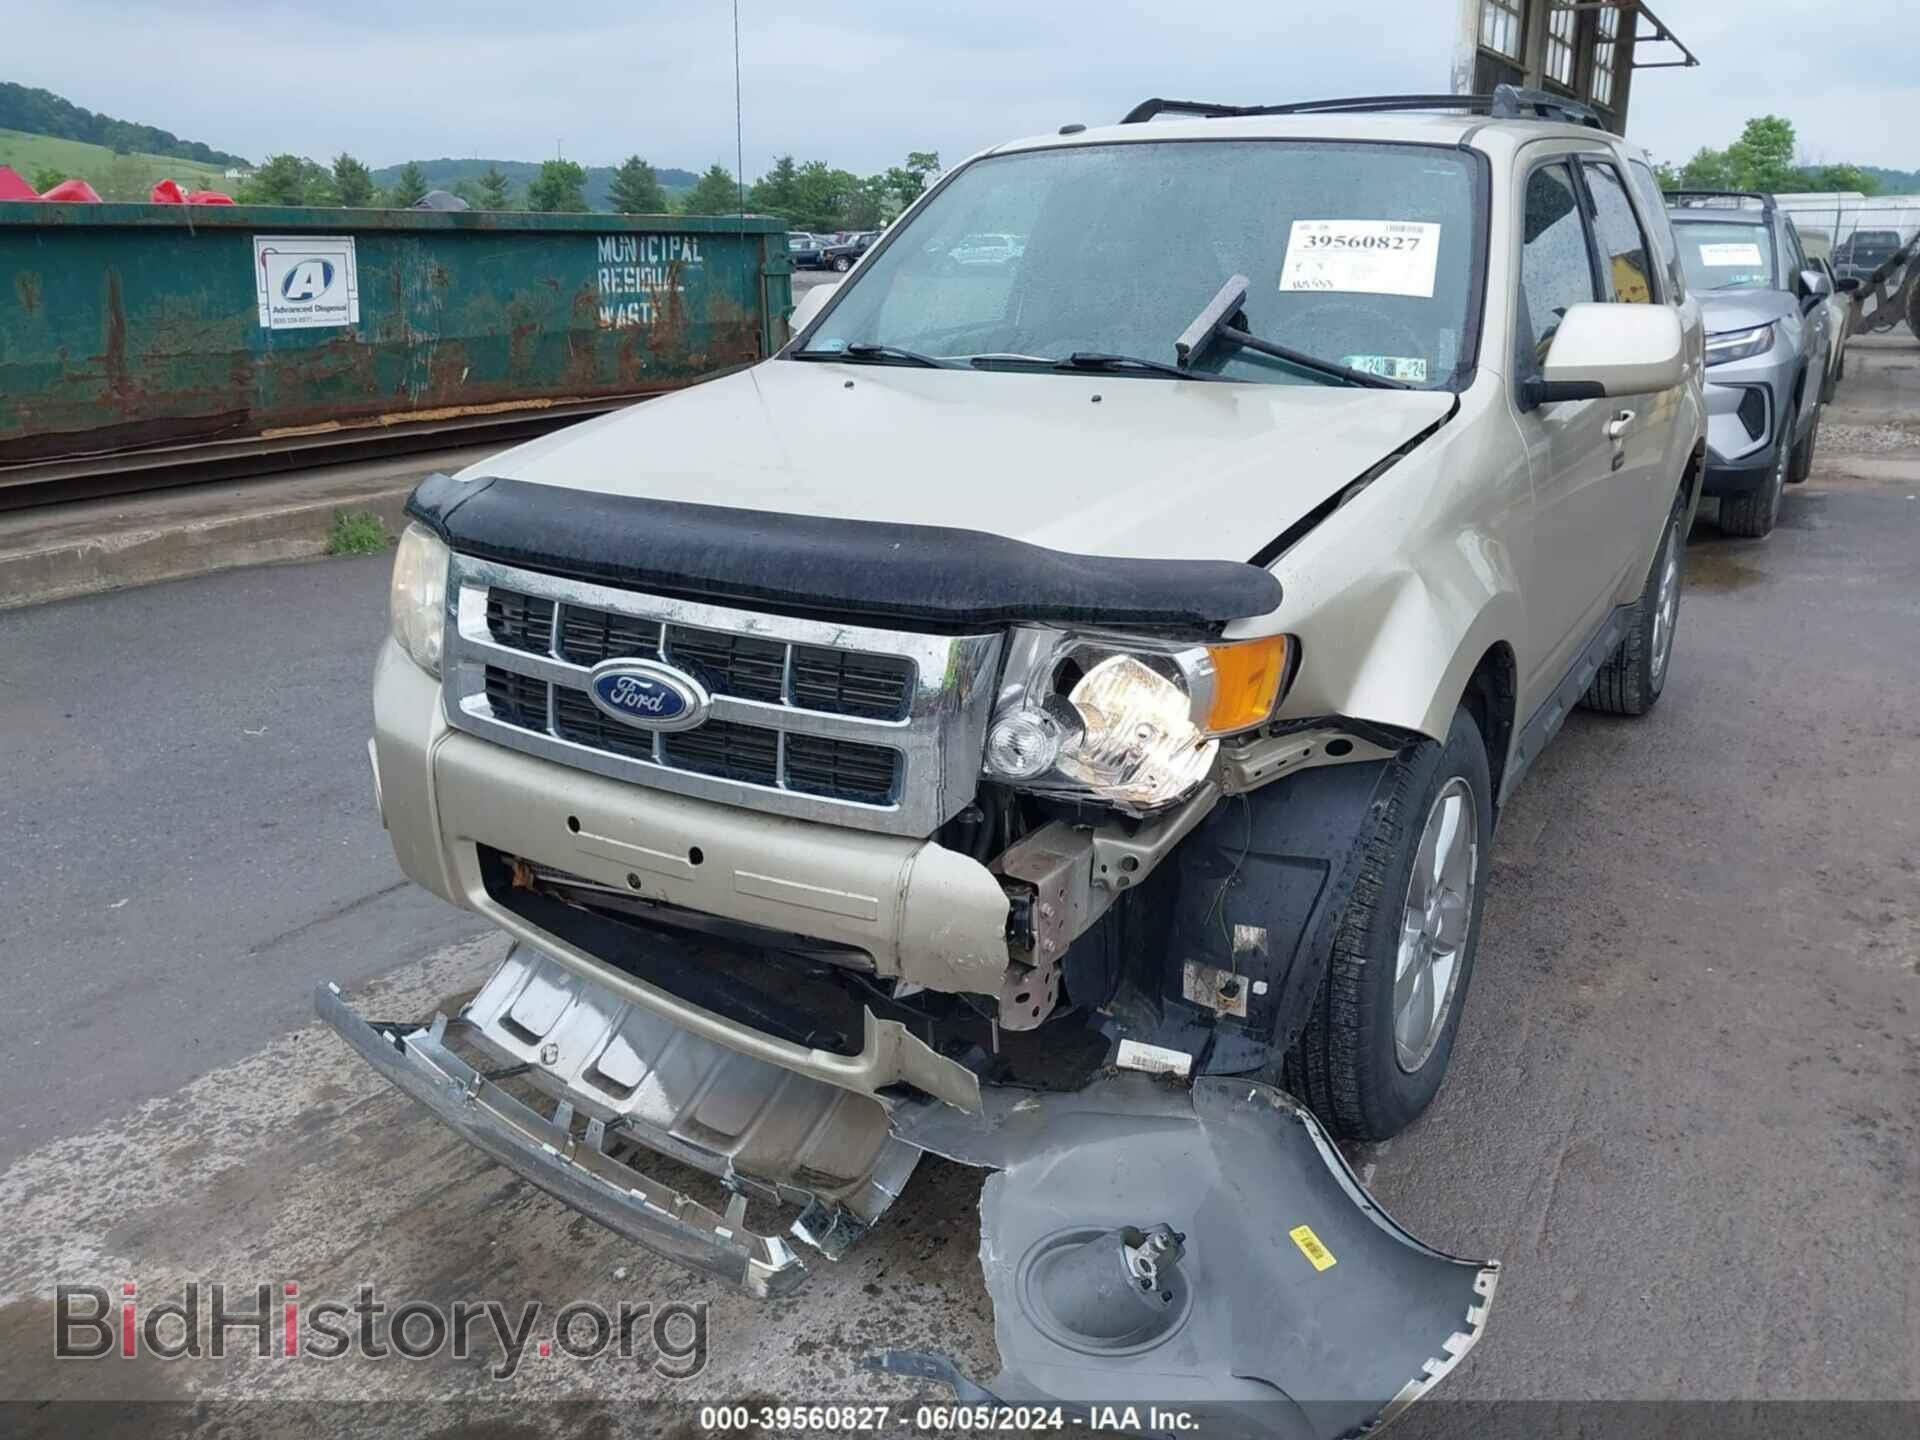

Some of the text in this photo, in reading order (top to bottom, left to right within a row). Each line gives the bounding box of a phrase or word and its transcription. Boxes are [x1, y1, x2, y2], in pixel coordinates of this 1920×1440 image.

[597, 235, 703, 264] MUNICIPAL
[1303, 234, 1421, 251] 39560827
[273, 303, 346, 313] Advanced Disposal
[610, 676, 666, 712] Ford
